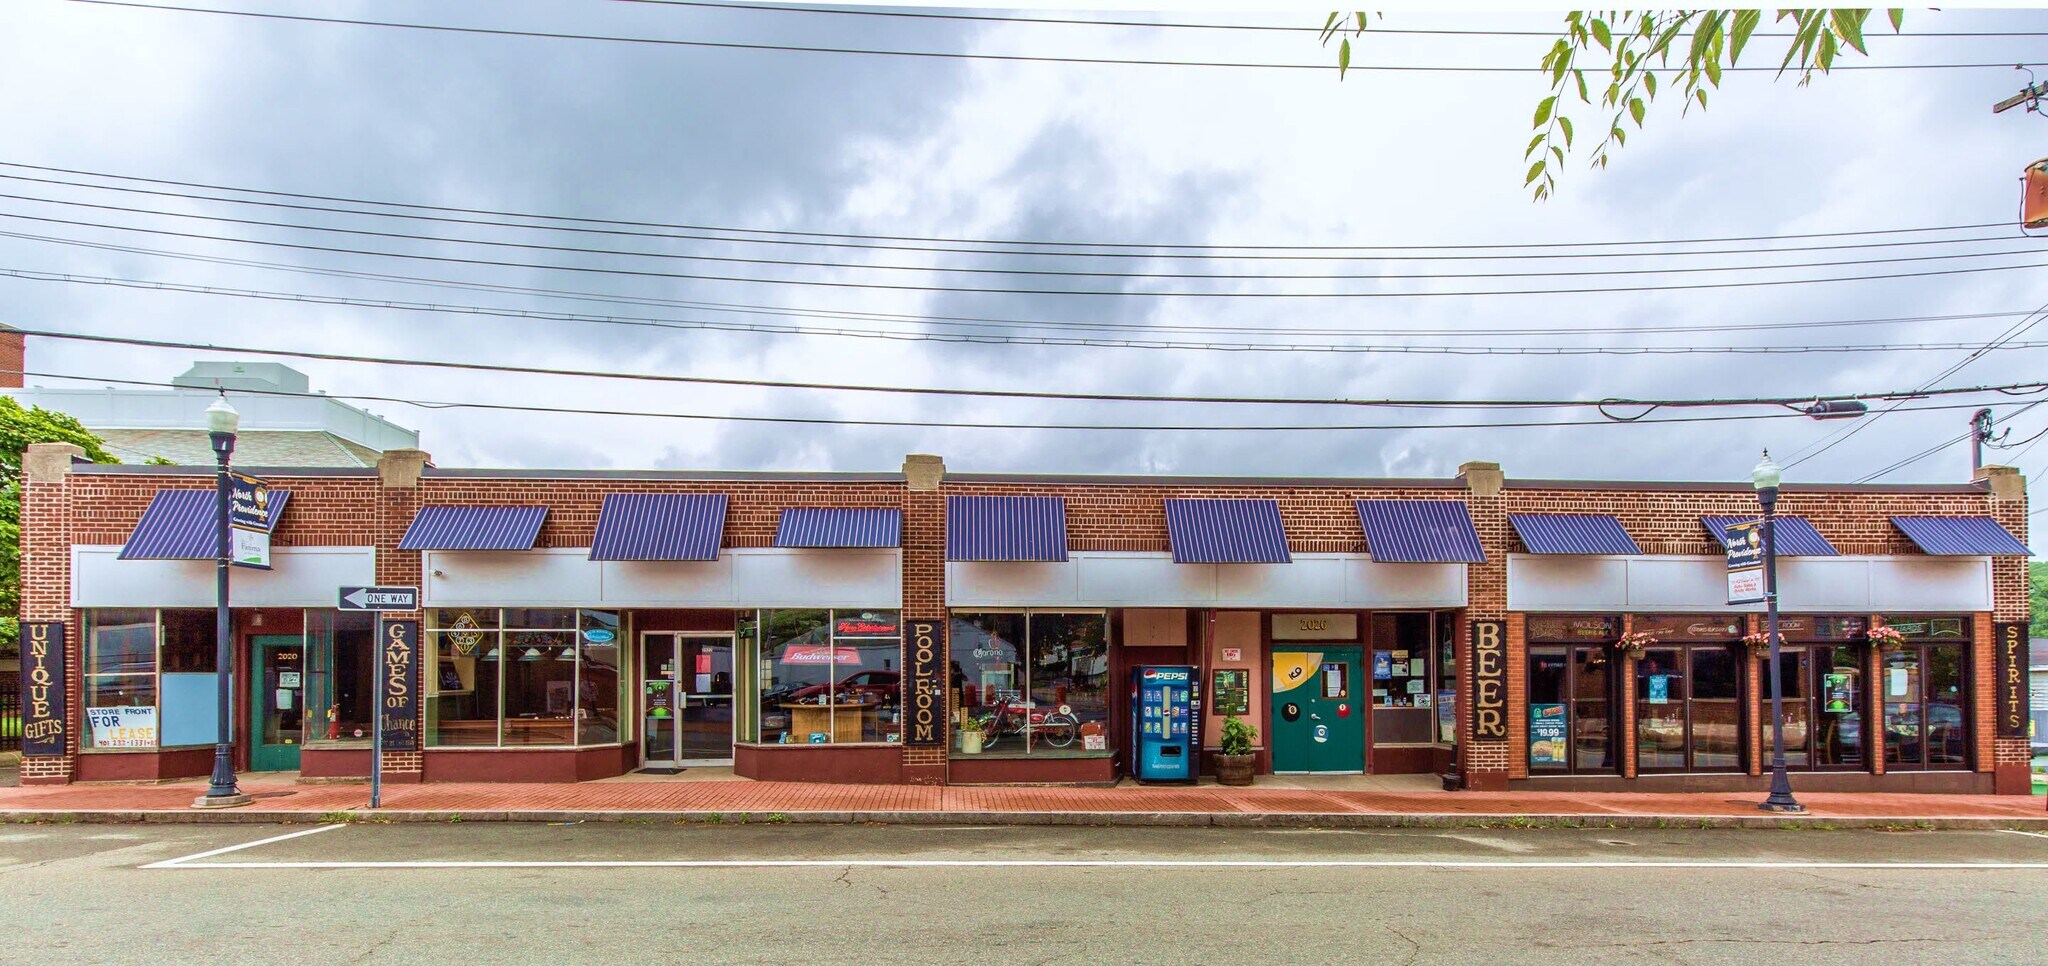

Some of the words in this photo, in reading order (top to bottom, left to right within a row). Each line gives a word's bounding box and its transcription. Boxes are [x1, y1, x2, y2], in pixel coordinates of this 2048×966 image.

[232, 488, 252, 502] North
[232, 500, 269, 518] Providence
[1726, 537, 1746, 549] North
[1727, 547, 1761, 560] Providence
[367, 594, 386, 603] ONE
[391, 594, 408, 603] WAY
[1573, 621, 1611, 631] MOLSON
[973, 648, 1003, 658] Corona
[385, 624, 410, 696] GAMES
[30, 624, 53, 717] UNIQUE
[1156, 672, 1188, 680] PEPSI
[2007, 626, 2020, 728] SPIRITS
[1477, 622, 1505, 737] BEER
[387, 697, 409, 708] OF
[90, 708, 120, 716] STORE
[91, 715, 121, 728] FOR
[381, 713, 416, 730] Chance
[25, 719, 62, 739] GIFTS
[109, 728, 154, 740] LEASE
[1537, 728, 1559, 737] $19.99
